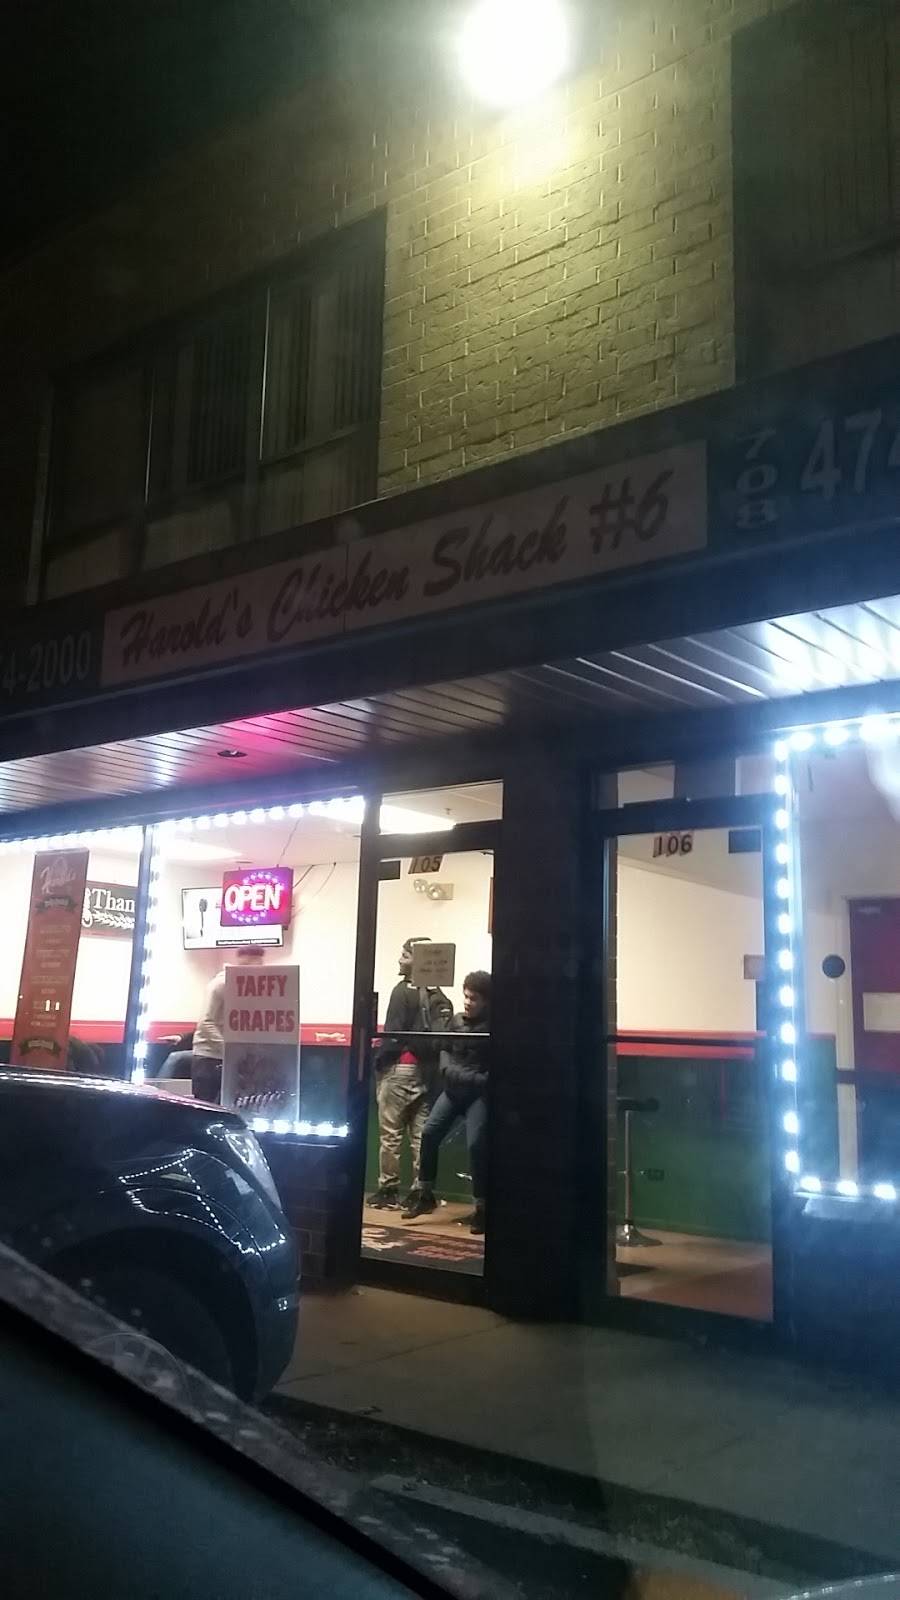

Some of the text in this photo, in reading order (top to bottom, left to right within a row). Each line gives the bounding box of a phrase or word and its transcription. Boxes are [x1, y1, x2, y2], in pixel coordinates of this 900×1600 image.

[120, 469, 674, 667] Harold's Chicken Shack #6
[654, 834, 693, 857] 106
[409, 855, 442, 874] 105
[225, 883, 281, 912] OPEN
[236, 975, 287, 997] TAFFY
[229, 1009, 296, 1032] GRAPES
